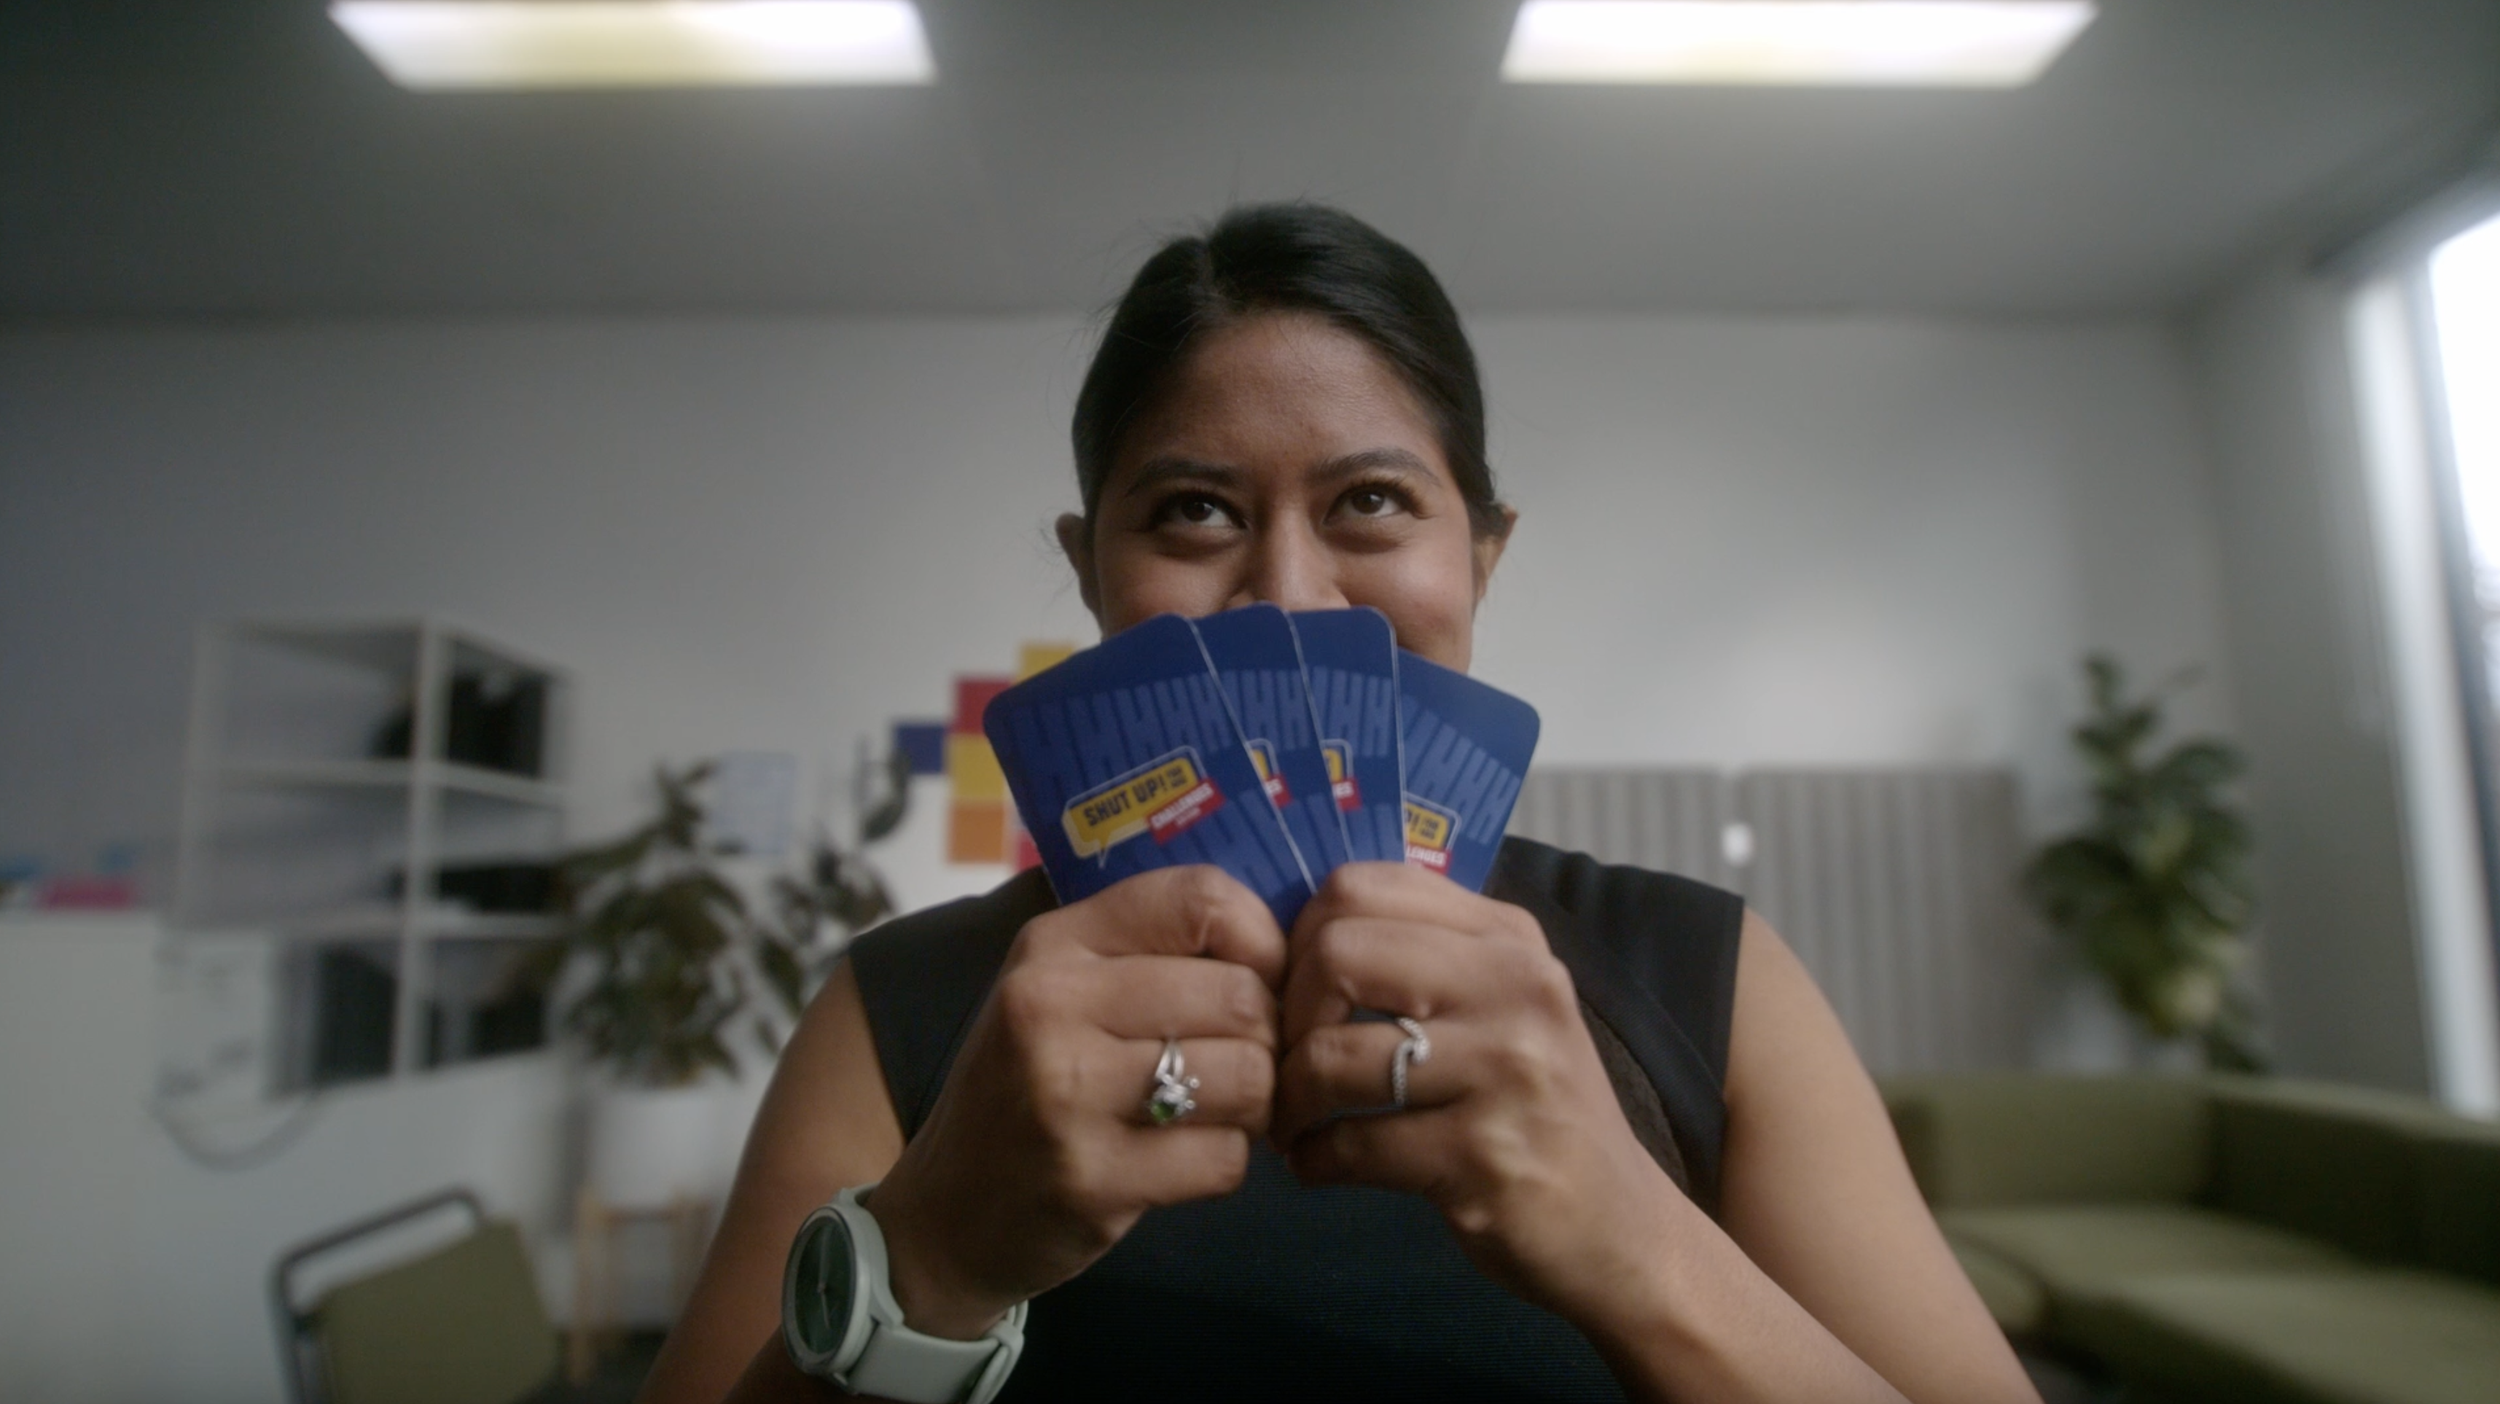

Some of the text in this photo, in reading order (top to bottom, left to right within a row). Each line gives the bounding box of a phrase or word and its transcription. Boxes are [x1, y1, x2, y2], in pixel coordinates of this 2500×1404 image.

[1083, 791, 1131, 827] SHUT
[1133, 775, 1168, 804] UP!
[1150, 781, 1215, 830] CHALLENGES
[1406, 843, 1447, 866] LENGES
